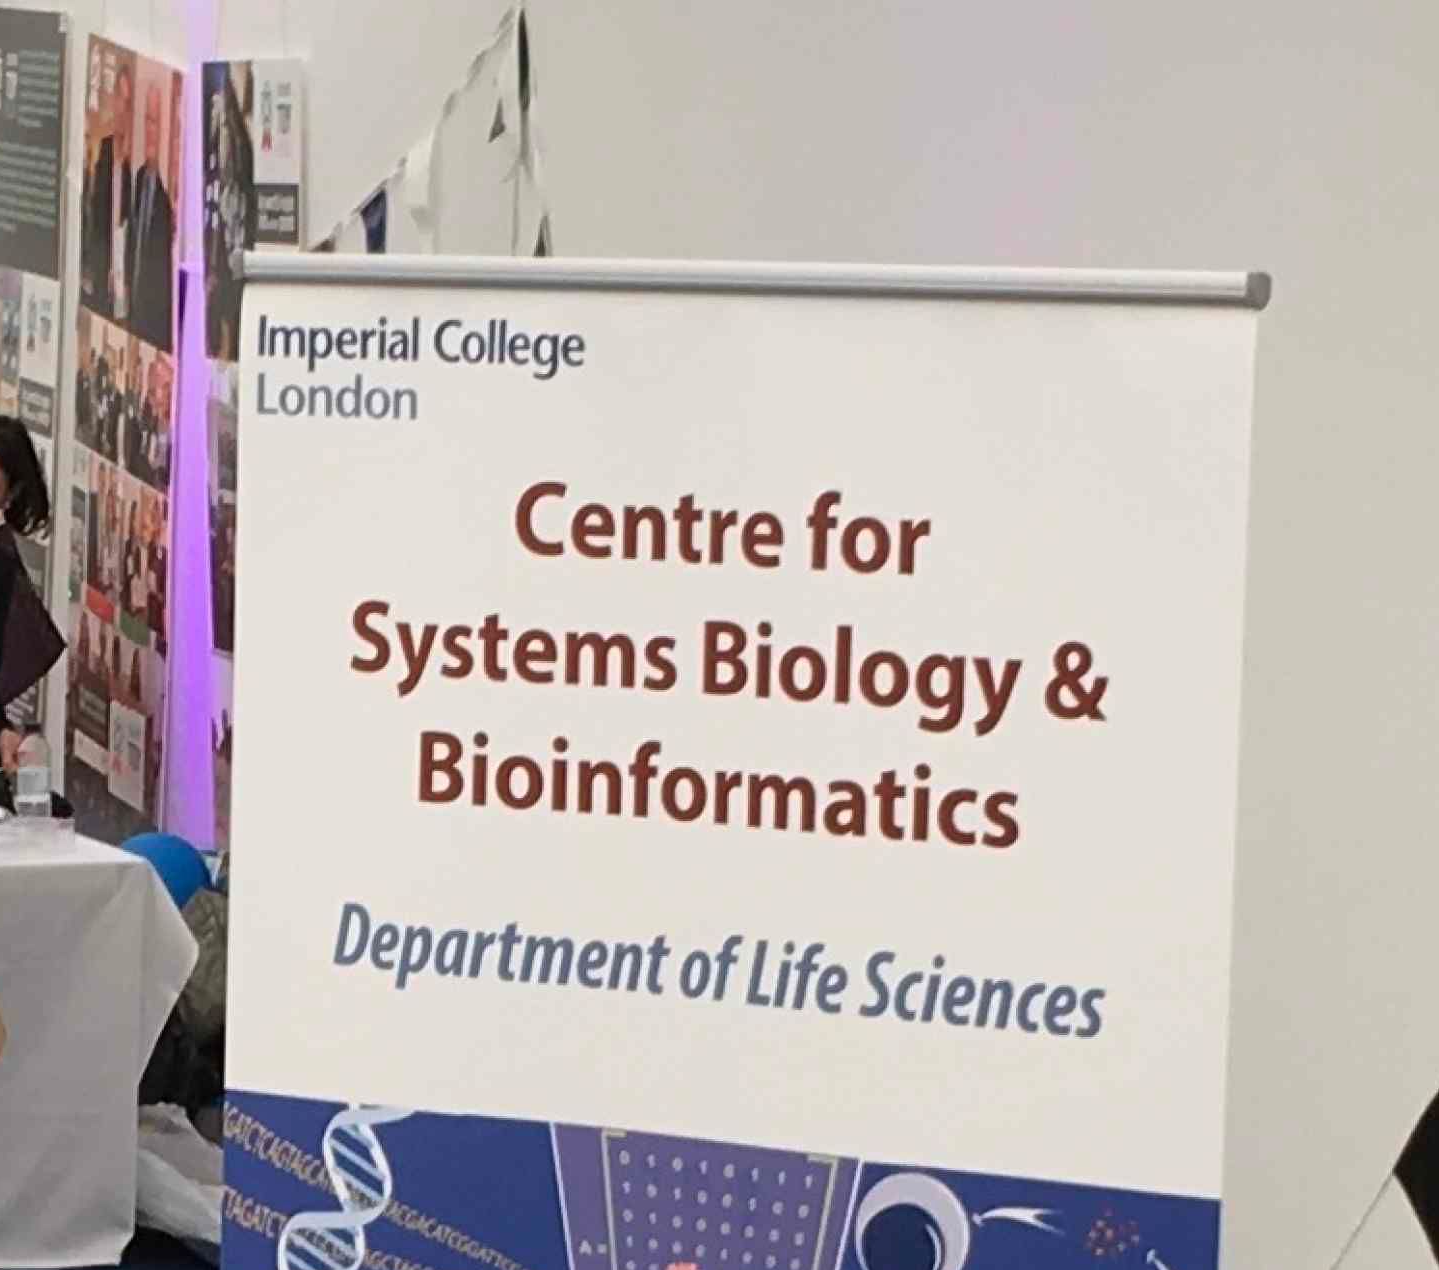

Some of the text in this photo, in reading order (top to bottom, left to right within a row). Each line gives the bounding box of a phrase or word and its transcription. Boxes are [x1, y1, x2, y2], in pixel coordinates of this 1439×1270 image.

[256, 372, 419, 421] London
[257, 315, 586, 381] Imperial College
[514, 481, 932, 577] Centre for
[350, 599, 1110, 737] Systems Biology &
[418, 730, 1020, 849] Bioinformatics
[333, 902, 1106, 1040] Department of Life Sciences
